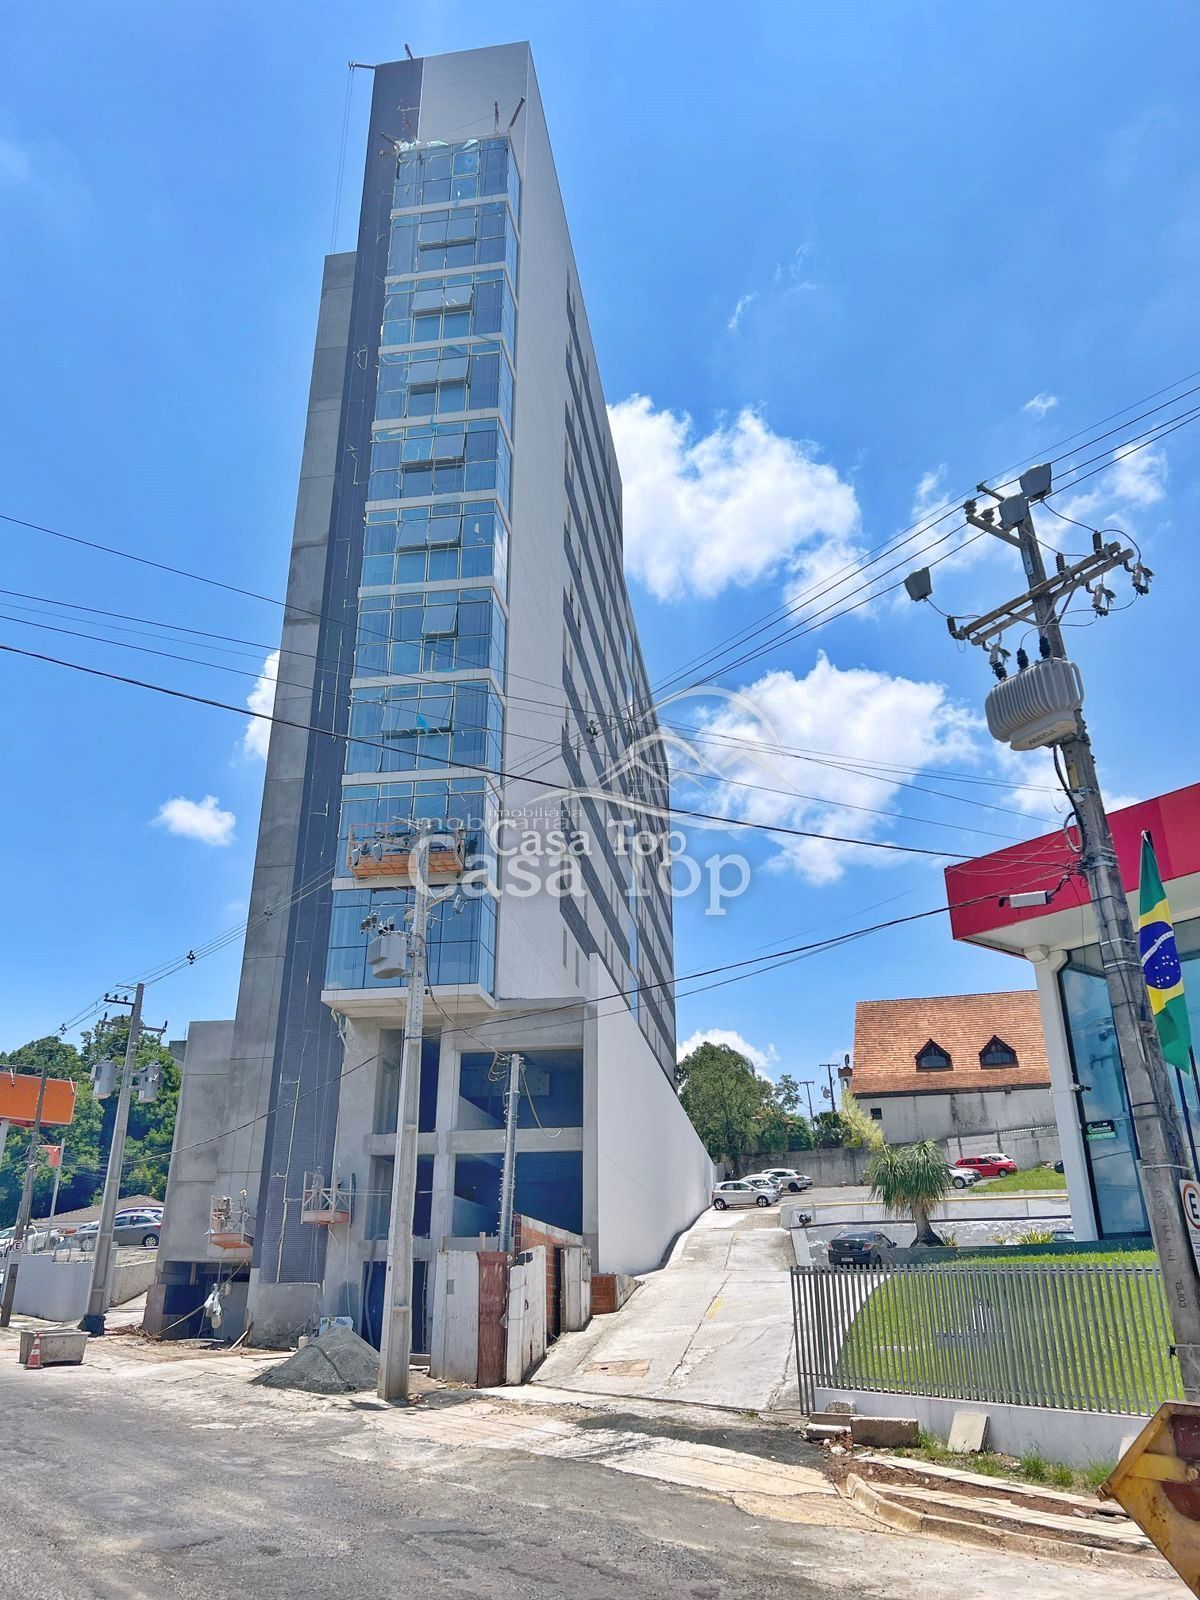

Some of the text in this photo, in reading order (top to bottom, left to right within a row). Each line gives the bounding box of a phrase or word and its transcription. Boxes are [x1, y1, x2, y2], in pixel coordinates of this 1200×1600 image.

[1188, 1192, 1200, 1219] E
[15, 1242, 21, 1250] E
[1175, 1279, 1187, 1308] COPEL
